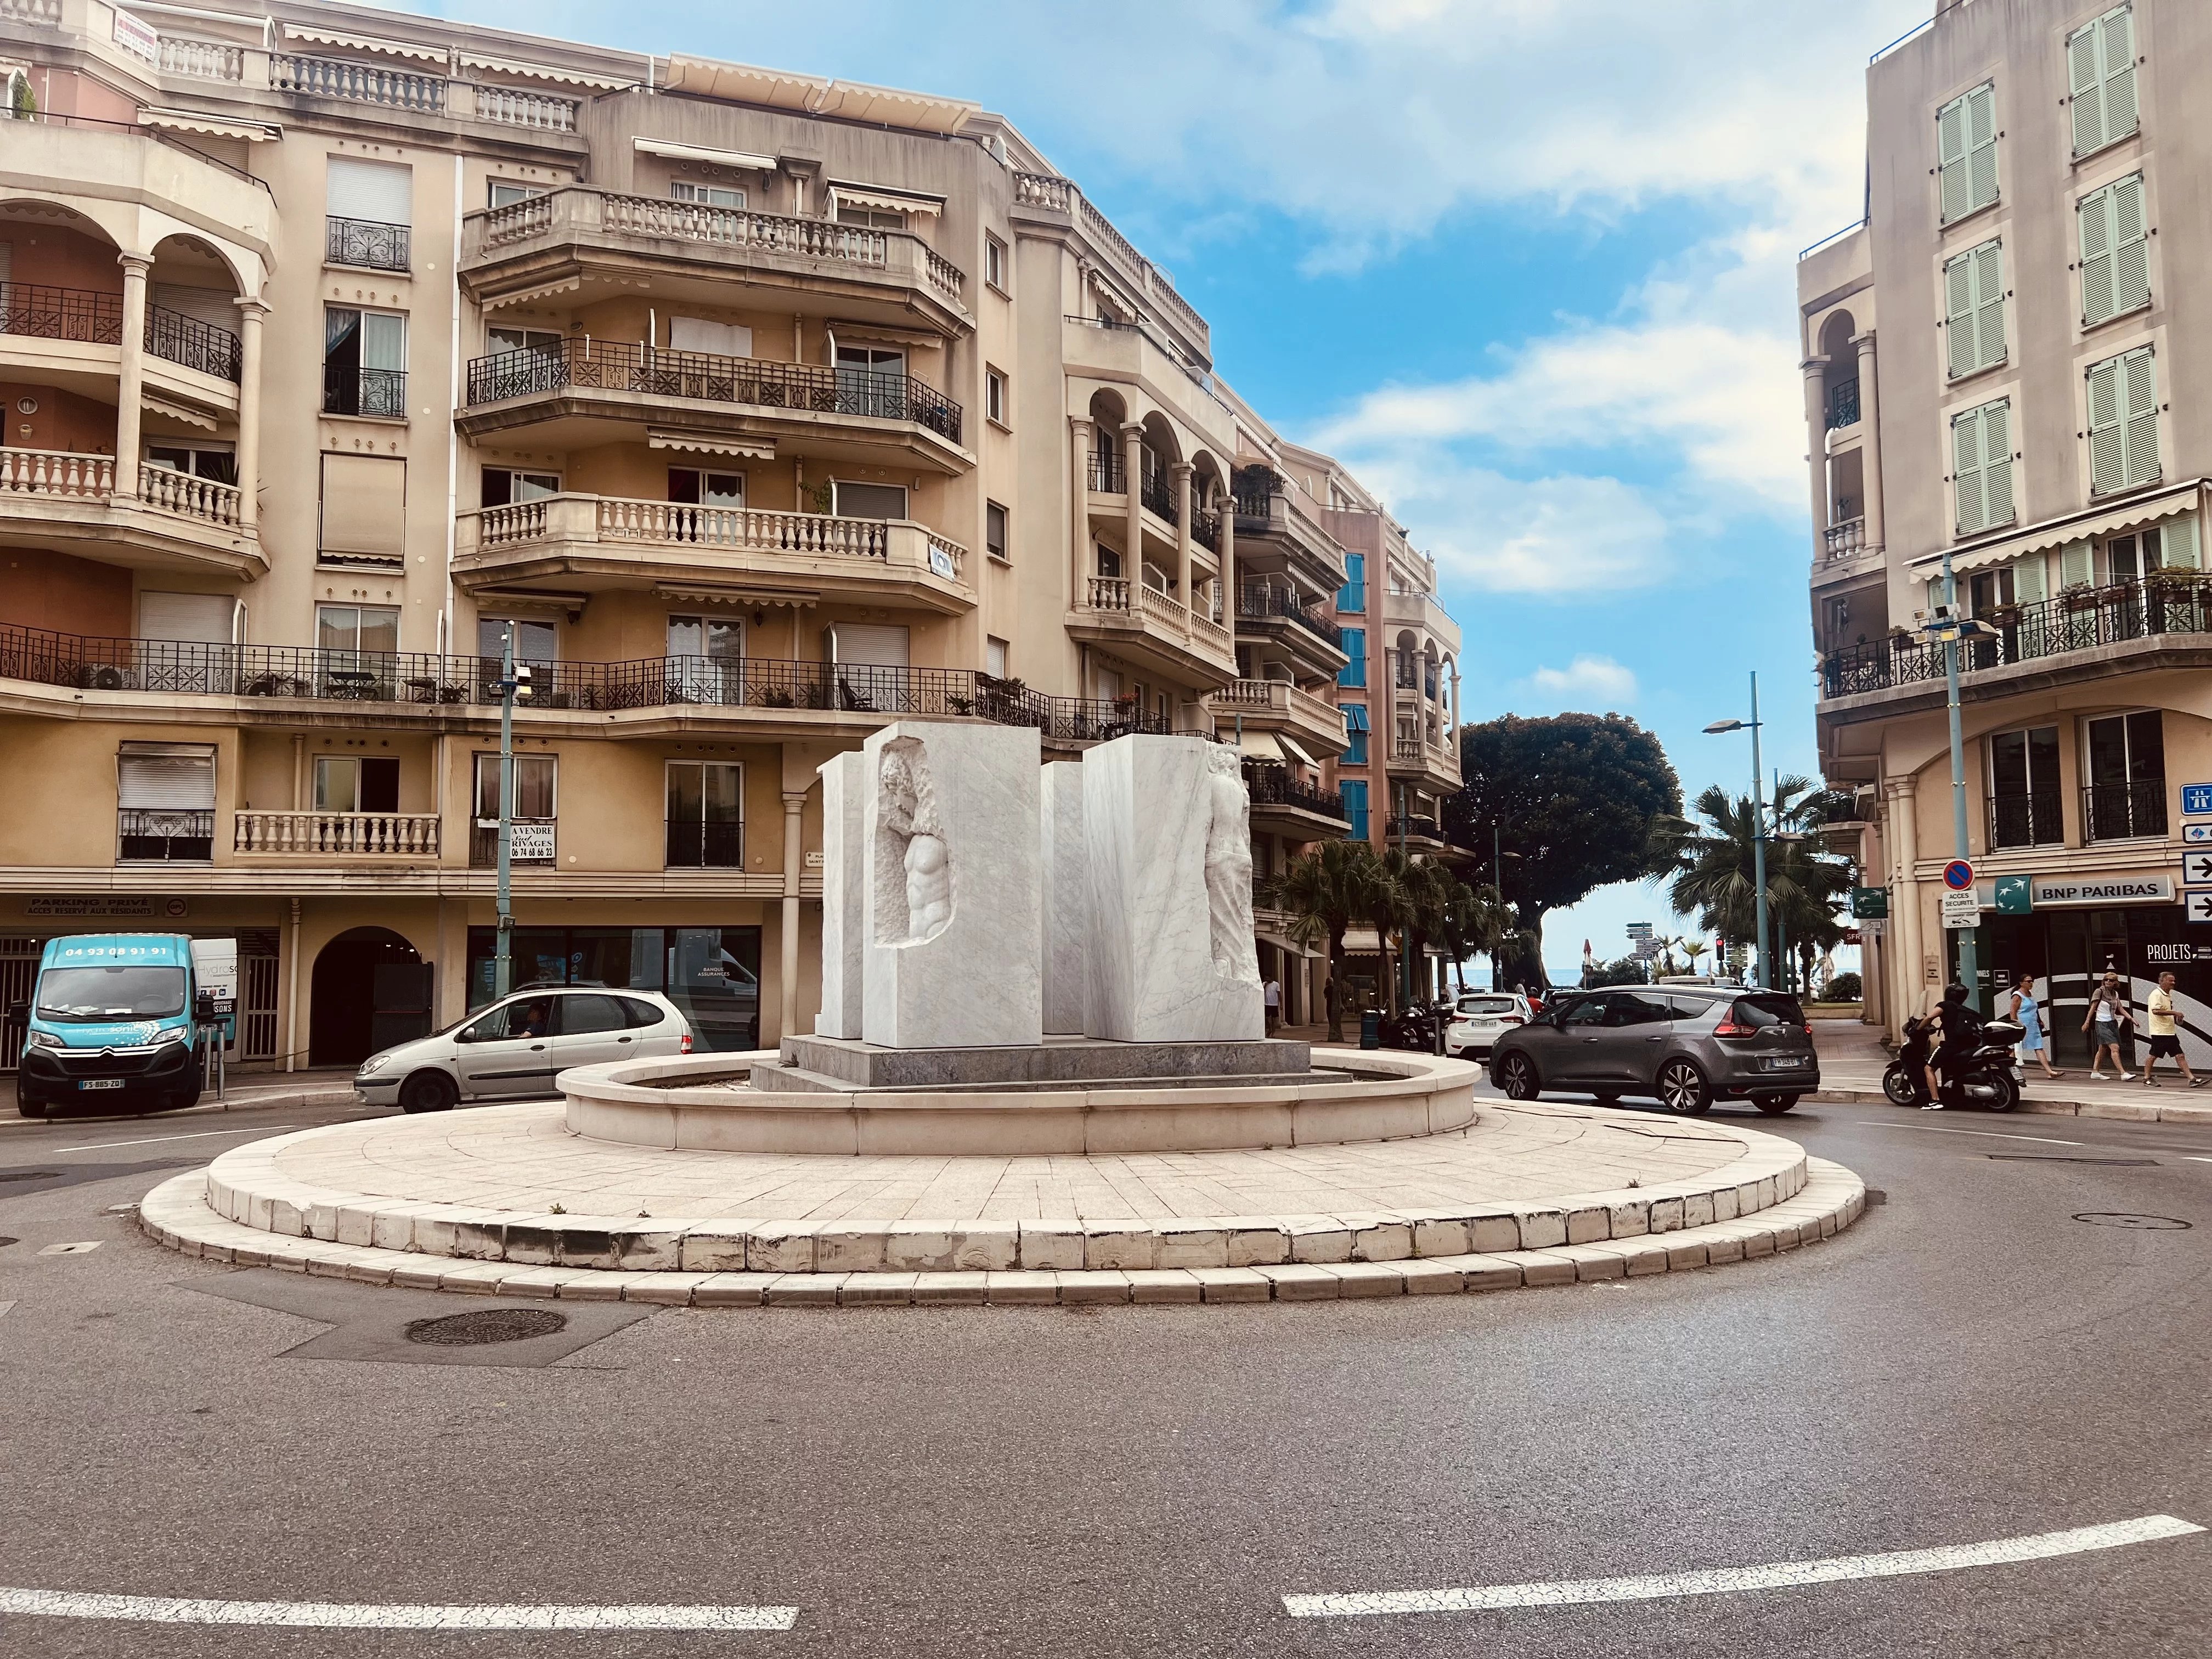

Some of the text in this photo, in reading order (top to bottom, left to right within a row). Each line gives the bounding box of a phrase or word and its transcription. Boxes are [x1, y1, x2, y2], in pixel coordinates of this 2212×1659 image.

[512, 848, 518, 856] 06
[2042, 883, 2158, 899] BNP PARIBAS
[108, 897, 149, 906] PRIVÉ
[65, 948, 83, 956] 04
[2147, 944, 2191, 960] PROJETS
